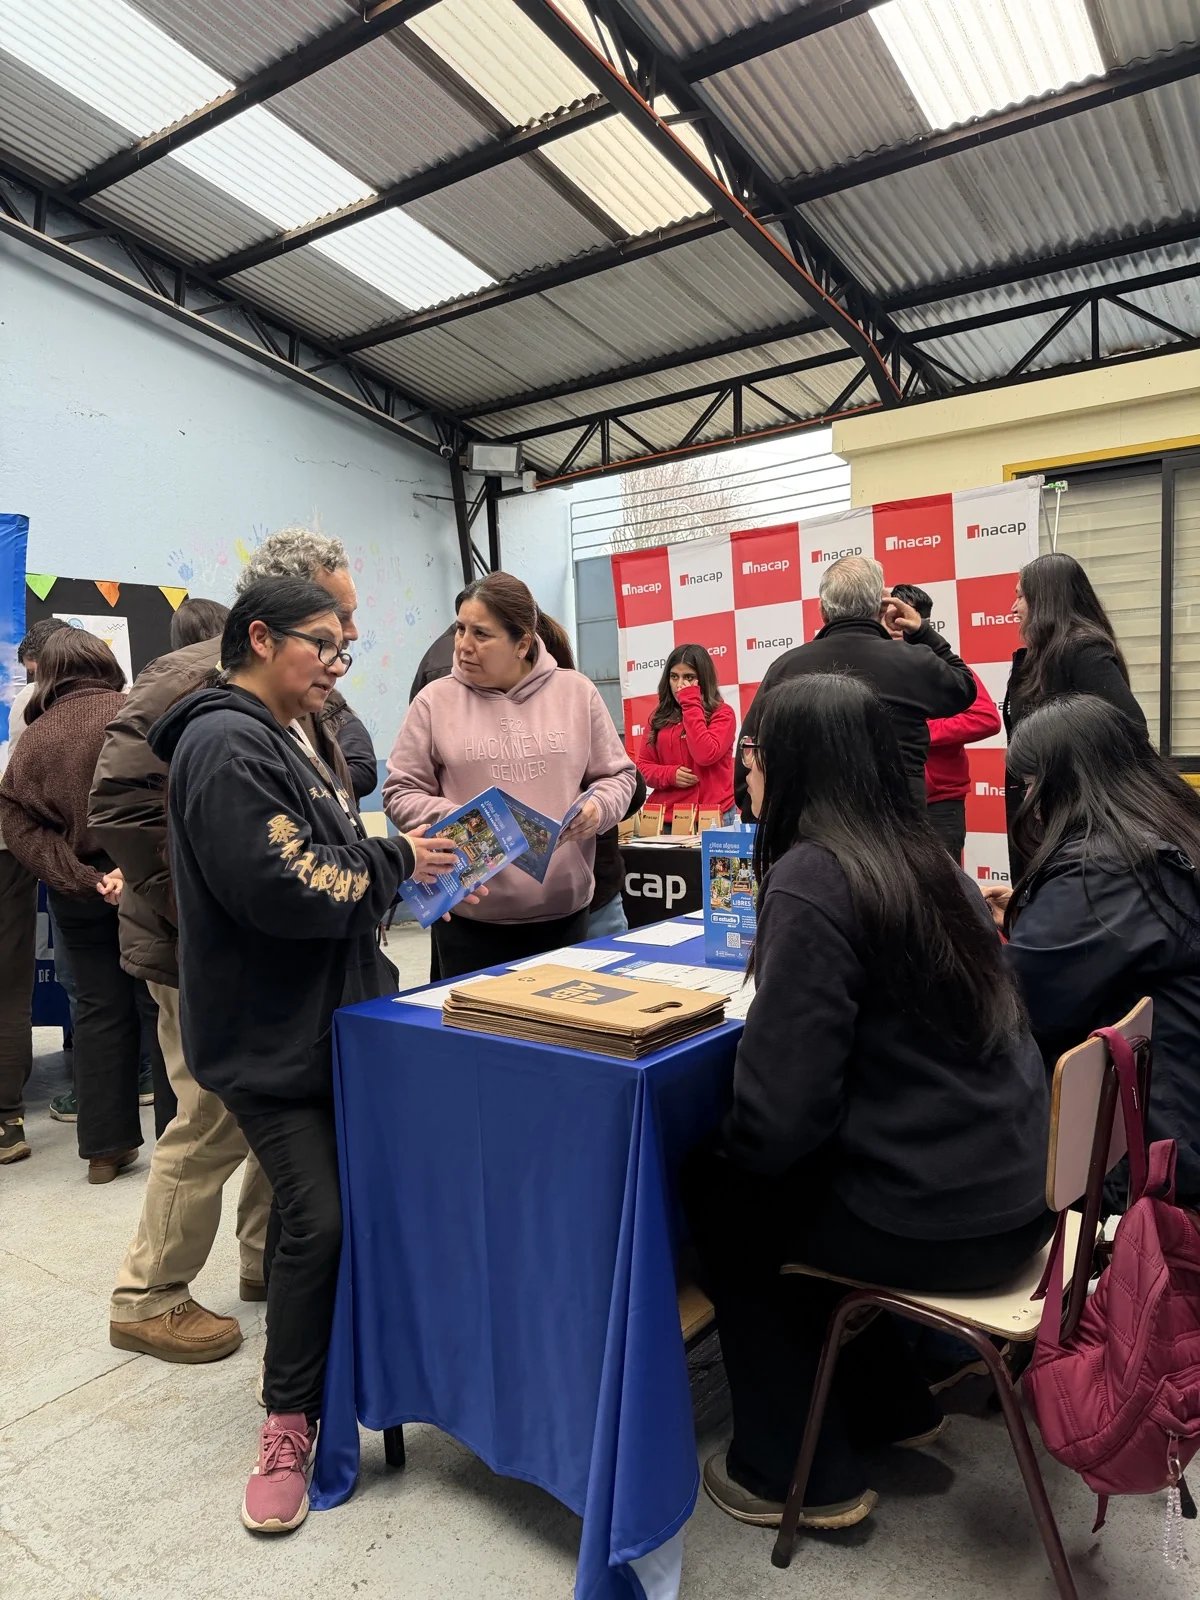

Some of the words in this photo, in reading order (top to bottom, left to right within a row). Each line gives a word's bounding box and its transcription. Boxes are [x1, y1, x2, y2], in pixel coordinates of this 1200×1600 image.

[971, 611, 1021, 627] inaca
[707, 645, 727, 657] cap
[500, 717, 526, 733] 522
[464, 733, 544, 762] HACKNEY
[546, 731, 567, 752] ST
[491, 760, 547, 783] DENVER
[975, 782, 1006, 796] ina
[977, 866, 1009, 882] ina
[625, 872, 687, 910] cap
[732, 899, 752, 907] LIBRES
[38, 969, 50, 983] DE
[549, 982, 597, 1000] AIEP
